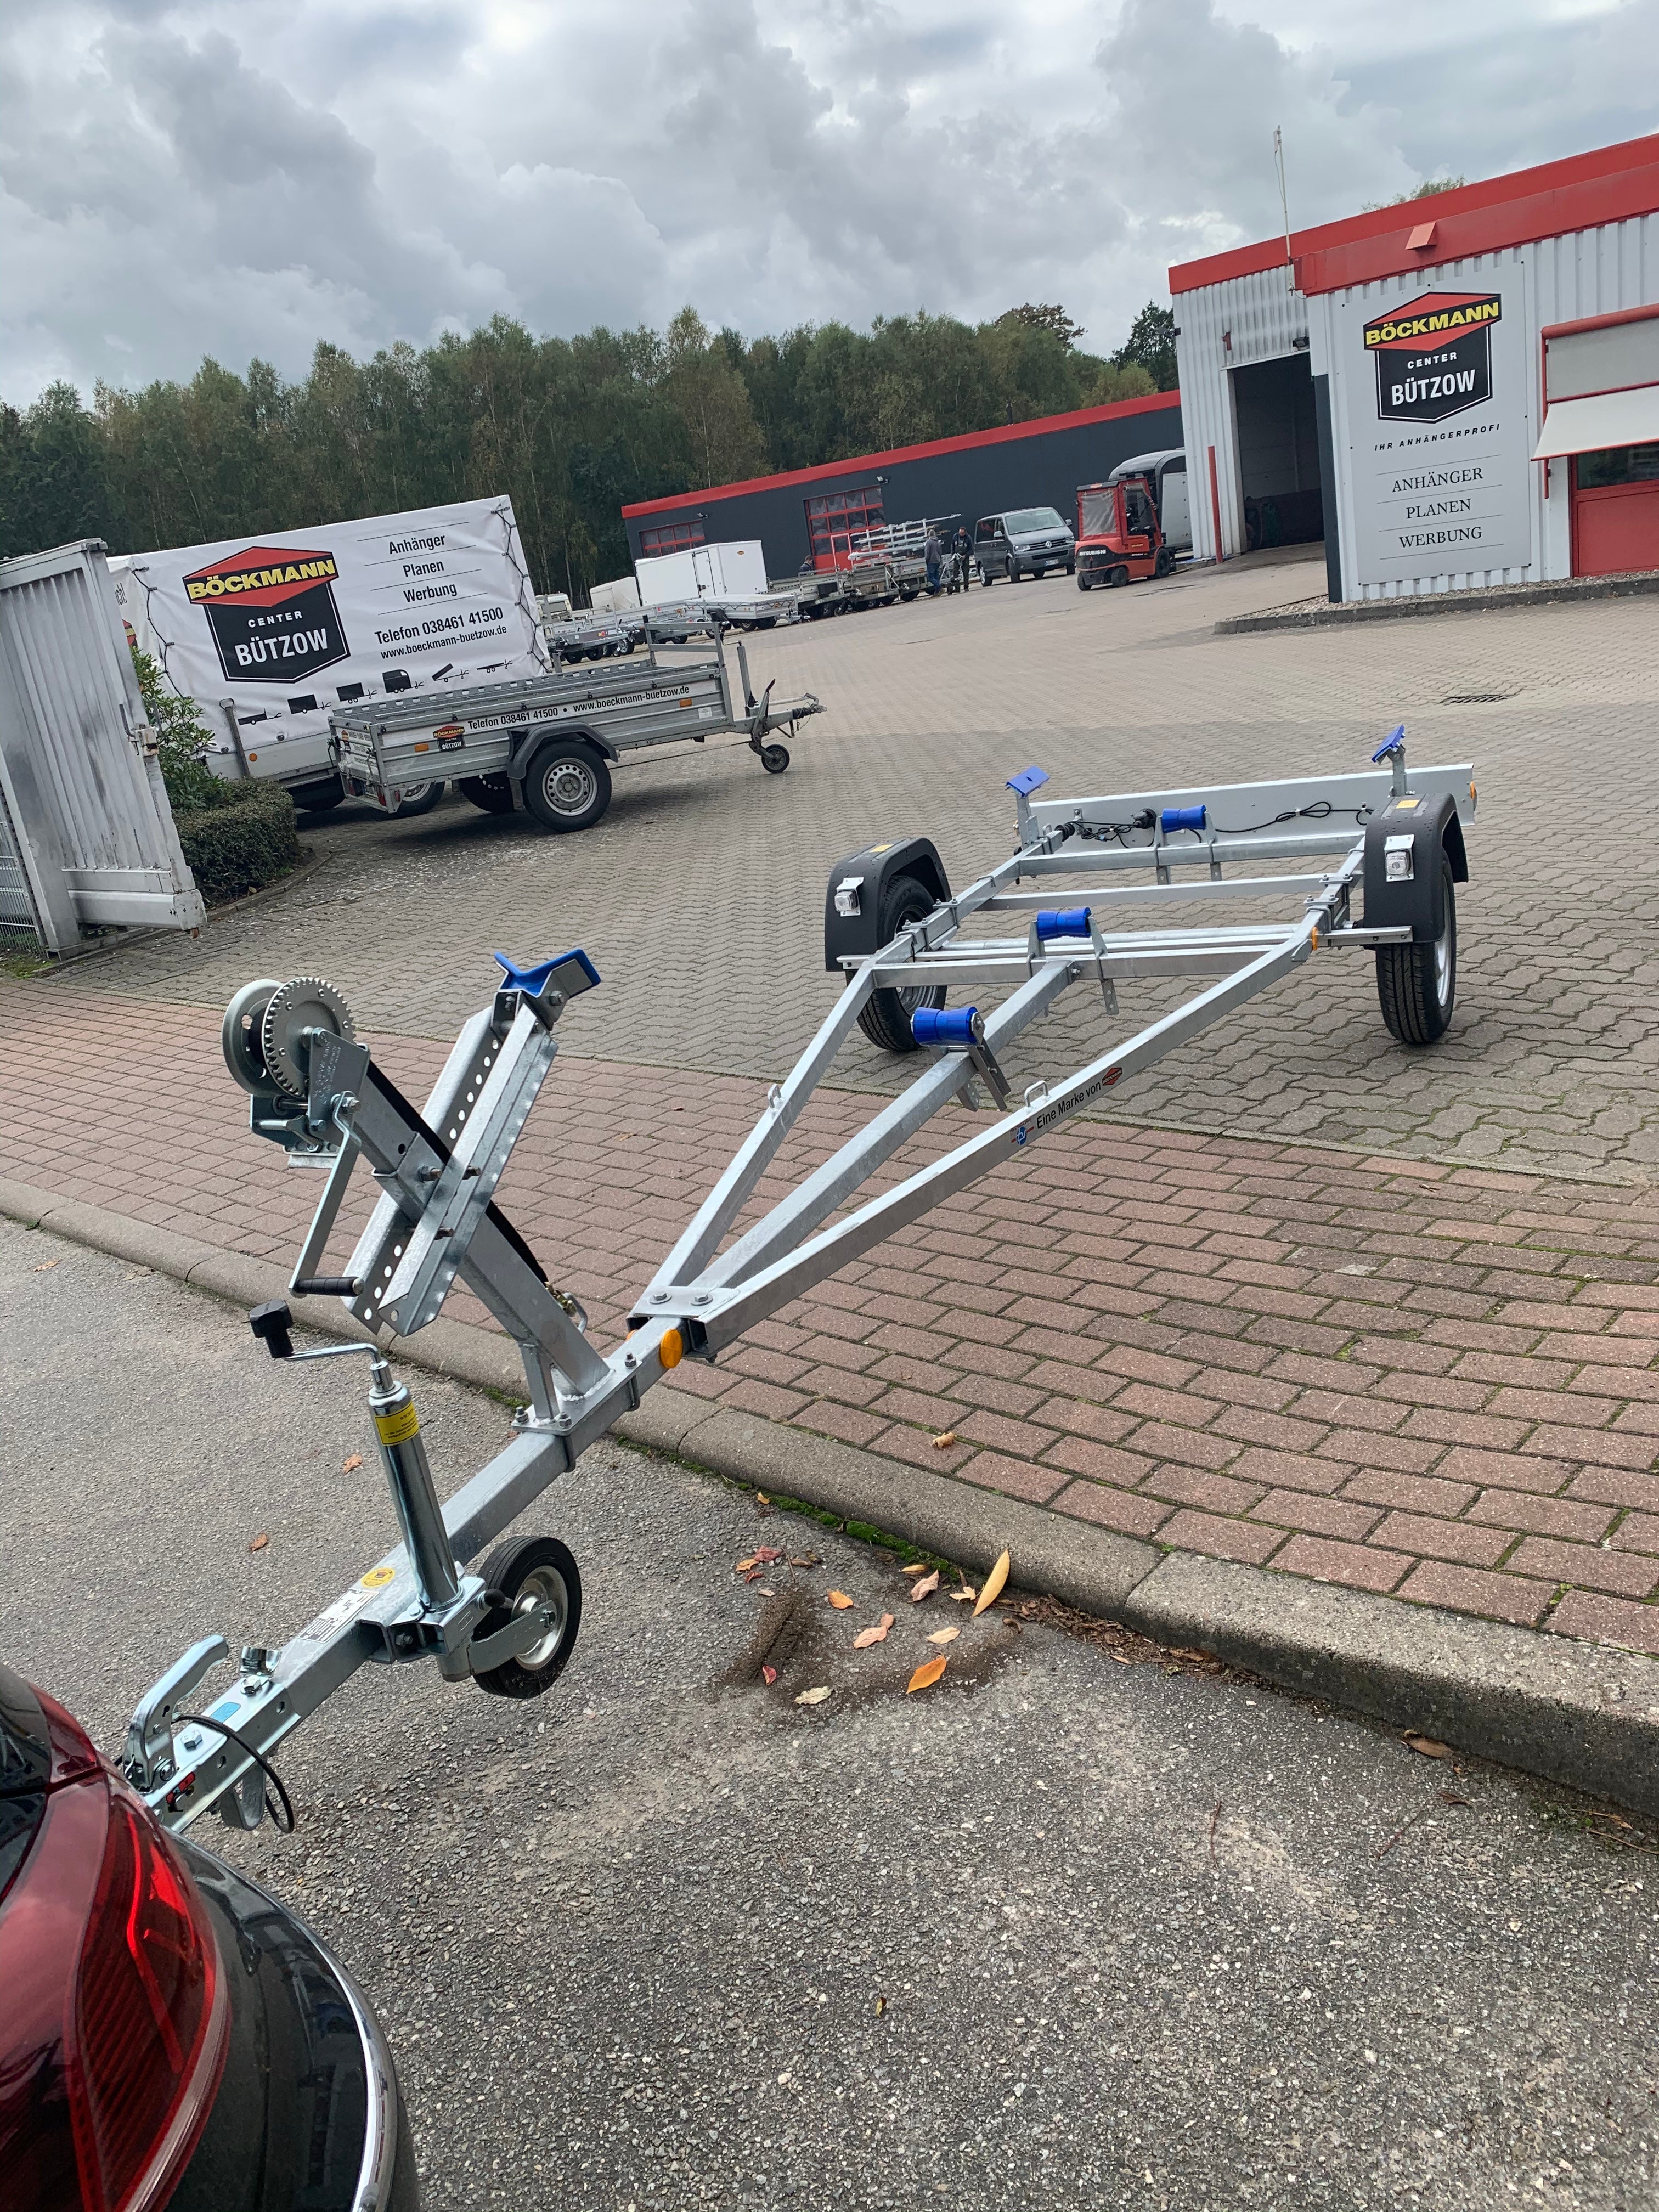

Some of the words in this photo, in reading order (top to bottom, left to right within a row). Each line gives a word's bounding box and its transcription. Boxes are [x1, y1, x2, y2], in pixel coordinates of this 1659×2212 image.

[1365, 302, 1499, 345] BÖCKMANN
[1222, 331, 1232, 351] 1
[1407, 352, 1458, 369] CENTER
[1391, 369, 1476, 405] BÜTZOW
[1374, 442, 1393, 452] IHR
[1399, 423, 1500, 447] ANHÄNGERPROFI
[1392, 467, 1483, 493] ANHÄNGER
[1406, 499, 1472, 520] PLANEN
[389, 535, 445, 555] Anhänger
[1398, 526, 1482, 549] WERBUNG
[187, 559, 336, 600] BÖCKMANN
[403, 561, 444, 578] Planen
[403, 584, 458, 603] Werbung
[247, 611, 303, 628] CENTER
[374, 626, 421, 645] Telefon
[422, 615, 465, 635] 038461
[469, 607, 504, 625] 41500
[234, 628, 328, 667] BÜTZOW
[380, 625, 507, 659] www.boeckmann-buetzow.de
[467, 718, 499, 730] Telefon
[500, 712, 531, 725] 038461
[533, 707, 558, 721] 41500
[573, 685, 690, 712] www.boeckmann-buetzow.de
[1036, 1110, 1057, 1129] Eine
[1058, 1092, 1085, 1116] Marke
[1085, 1081, 1101, 1097] von
